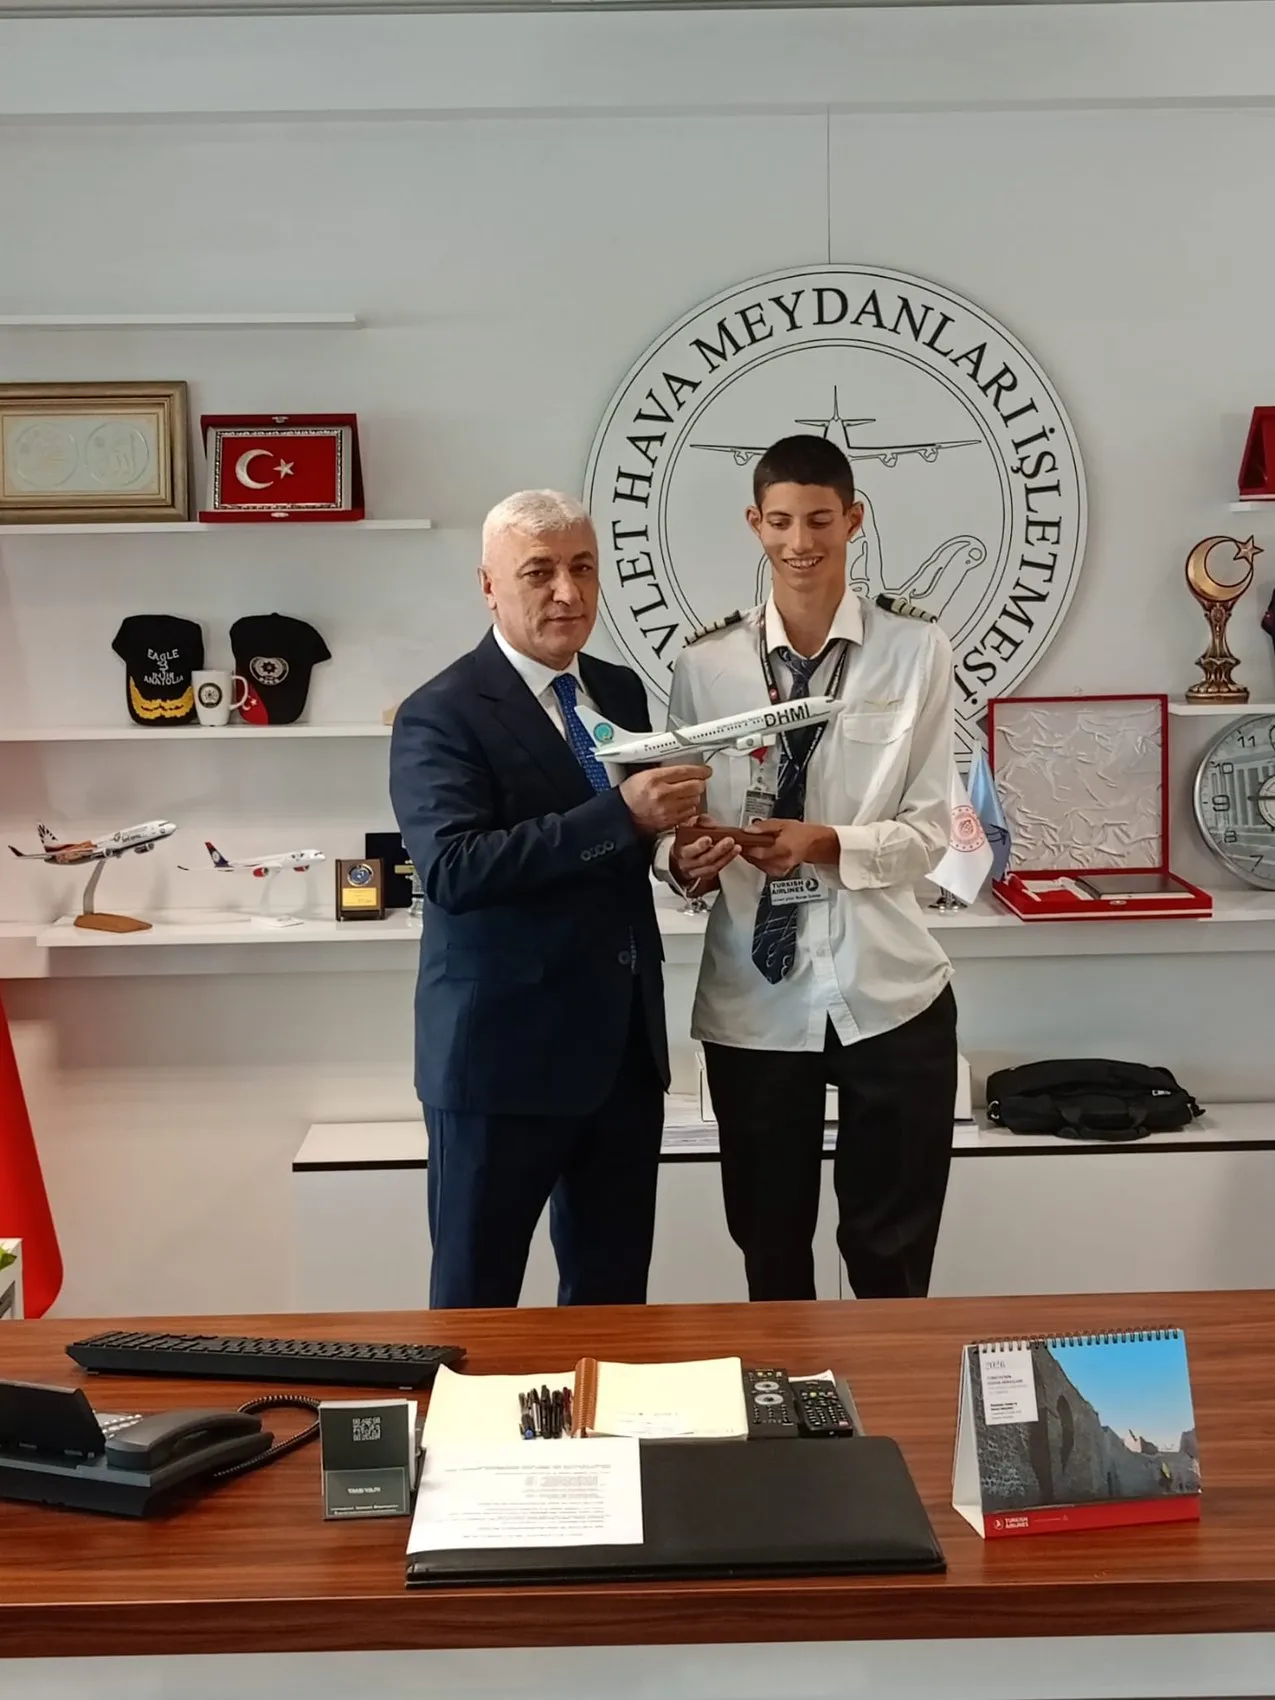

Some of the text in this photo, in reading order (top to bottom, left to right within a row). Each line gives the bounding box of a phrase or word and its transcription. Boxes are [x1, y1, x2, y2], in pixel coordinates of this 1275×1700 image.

[612, 287, 1062, 705] VLET HAVA MEYDANLARI İŞLETMESİ
[147, 648, 180, 661] EAGLE
[1237, 735, 1257, 748] 11
[1215, 762, 1234, 775] 10
[1212, 794, 1230, 812] 9
[1224, 830, 1238, 843] 8
[772, 880, 804, 889] TURKISH
[772, 886, 805, 895] AIRLINES
